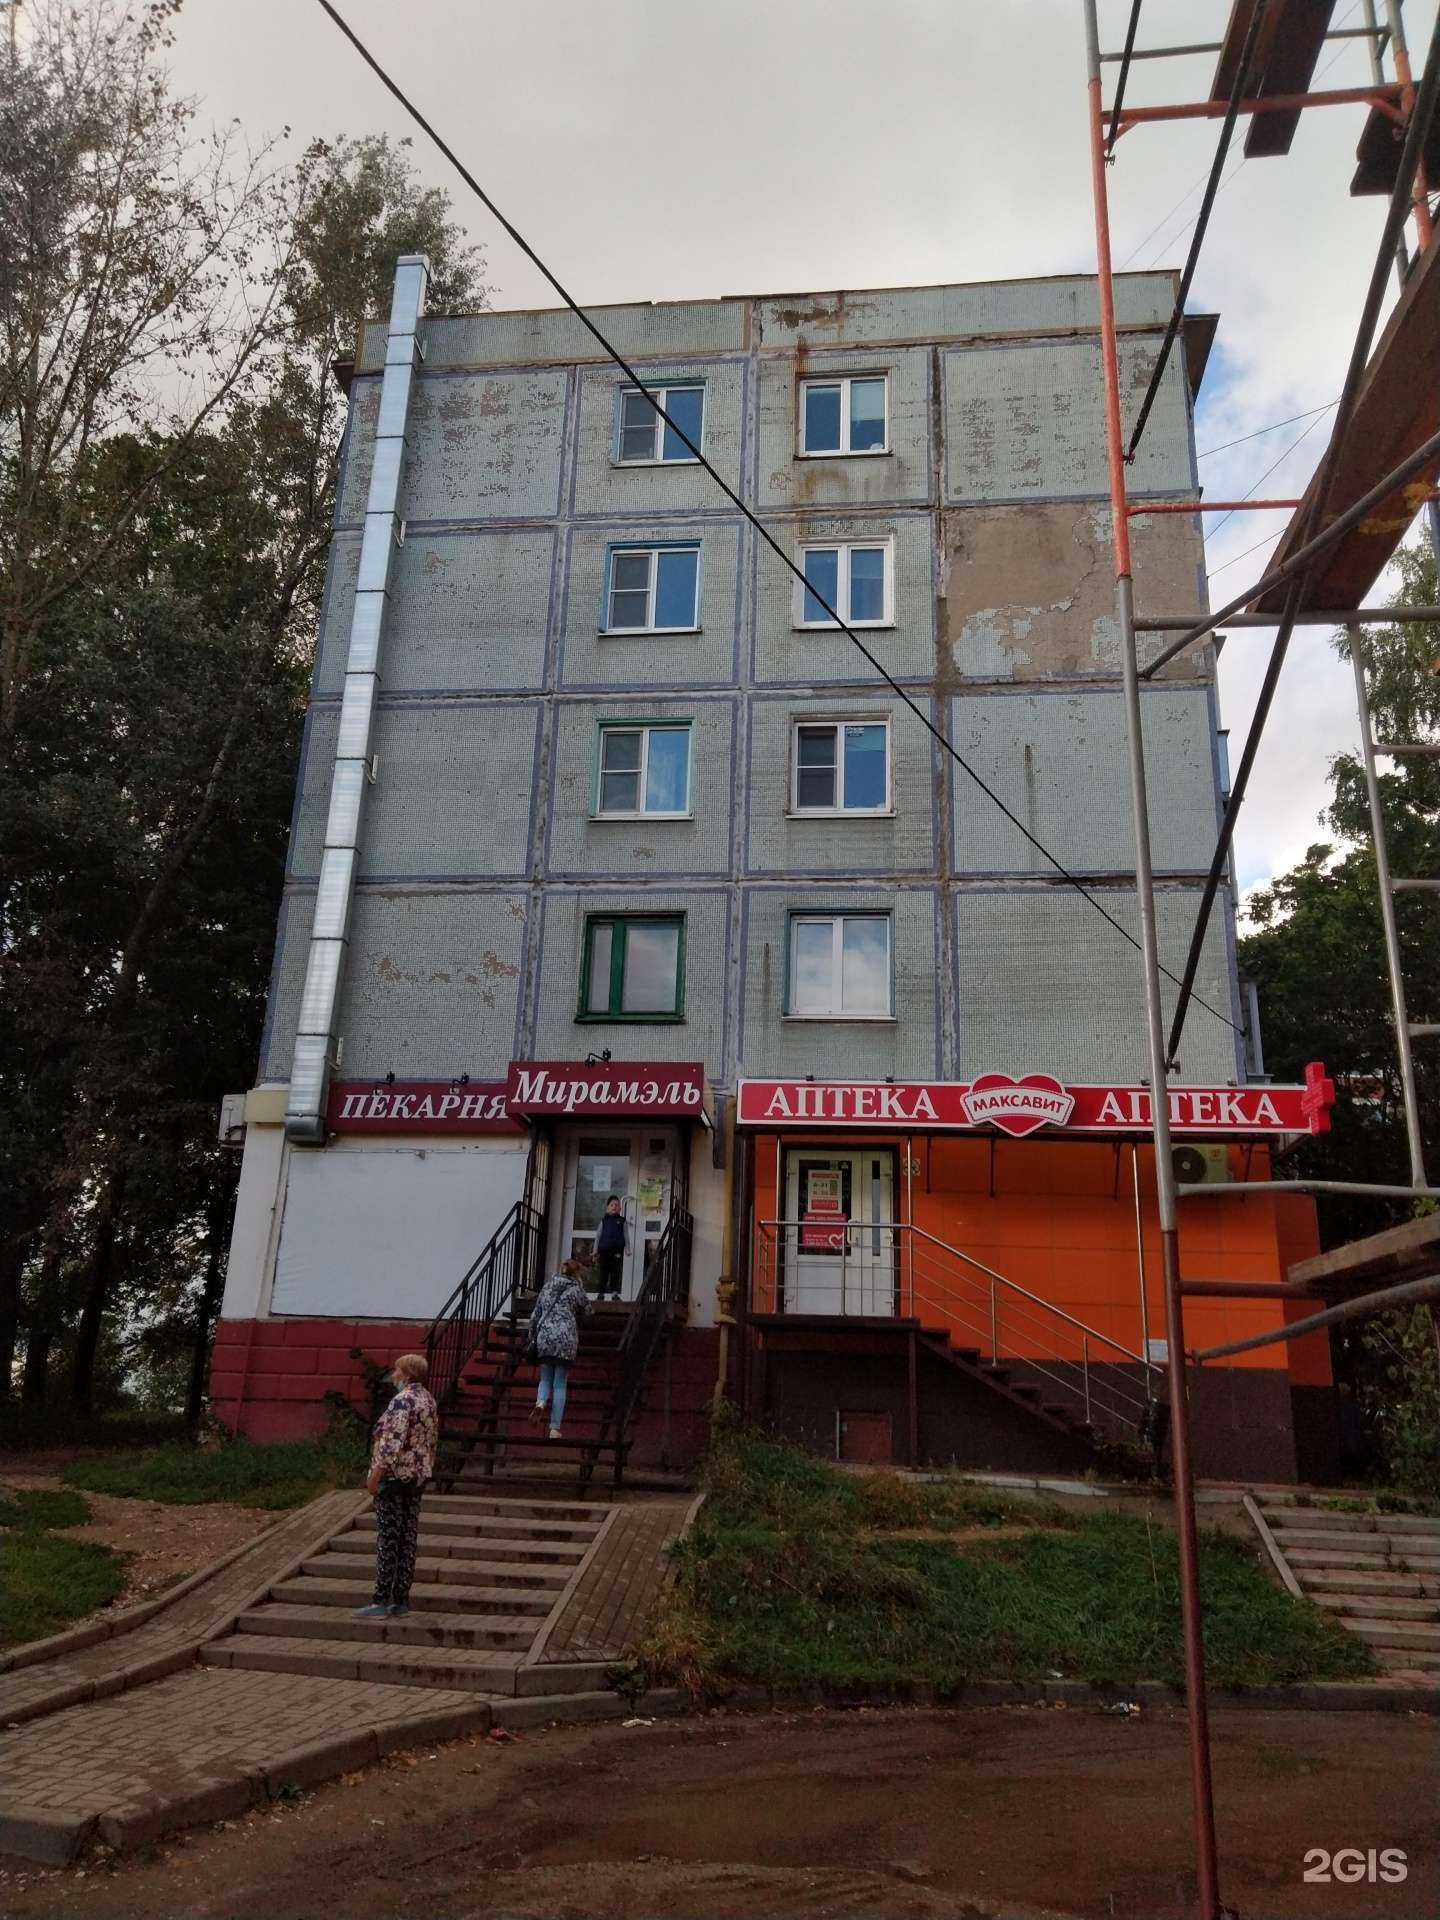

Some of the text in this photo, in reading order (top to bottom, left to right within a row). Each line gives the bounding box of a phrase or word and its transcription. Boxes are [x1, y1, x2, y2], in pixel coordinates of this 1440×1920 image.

[512, 1071, 701, 1112] Мирамэль
[764, 1087, 939, 1120] АПТЕКА
[973, 1093, 1064, 1115] МАКСАВИТ
[339, 1094, 509, 1119] ПЕКАРНЯ
